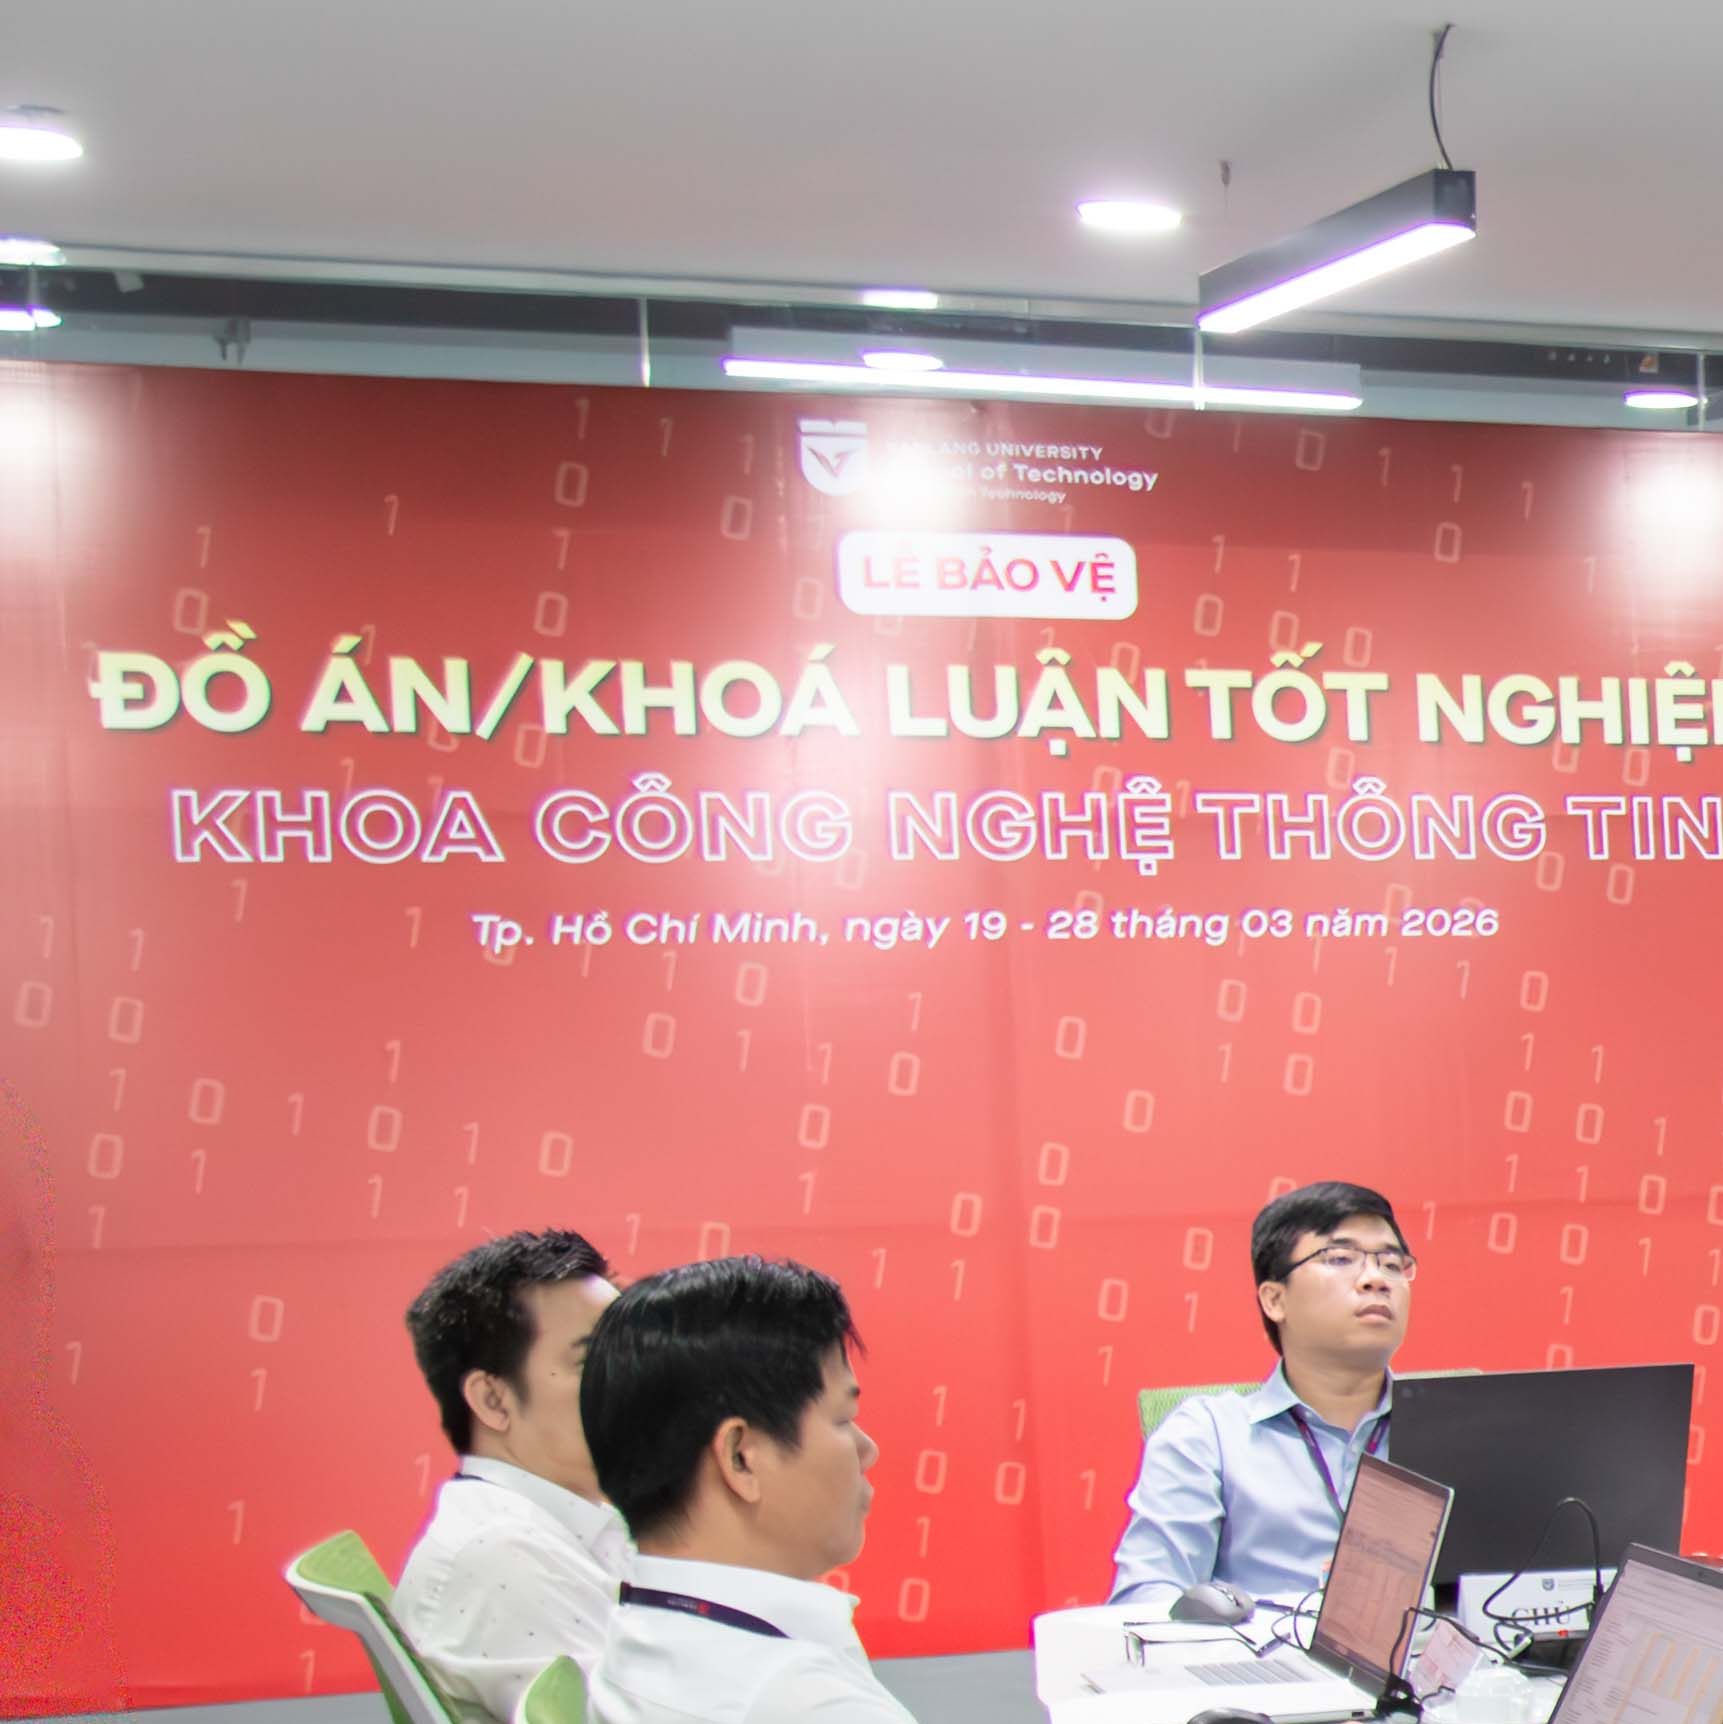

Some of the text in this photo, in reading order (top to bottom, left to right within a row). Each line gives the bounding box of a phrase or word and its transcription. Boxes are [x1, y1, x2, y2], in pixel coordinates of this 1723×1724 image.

[986, 442, 1105, 461] UNIVERSITY
[980, 463, 1009, 482] of
[1013, 463, 1159, 492] Technology
[936, 545, 1040, 592] BẢO
[1049, 552, 1117, 602] VỆ
[88, 619, 271, 733] ĐỒ
[299, 634, 860, 740] ÁN/KHOÁ
[887, 647, 1170, 756] LUẬN
[1184, 642, 1389, 742] TỐT
[171, 788, 505, 864] KHOA
[535, 772, 853, 864] CÔNG
[887, 776, 1175, 876] NGHỆ
[1195, 776, 1547, 861] THÔNG
[471, 913, 535, 953] Tp.
[551, 910, 612, 945] Hồ
[625, 911, 701, 945] Chí
[712, 912, 831, 947] Minh,
[845, 913, 951, 950] ngày
[963, 910, 1007, 941] 19
[1047, 910, 1099, 940] 28
[1110, 908, 1229, 947] tháng
[1241, 909, 1293, 938] 03
[1305, 908, 1388, 938] năm
[1401, 907, 1499, 938] 2026
